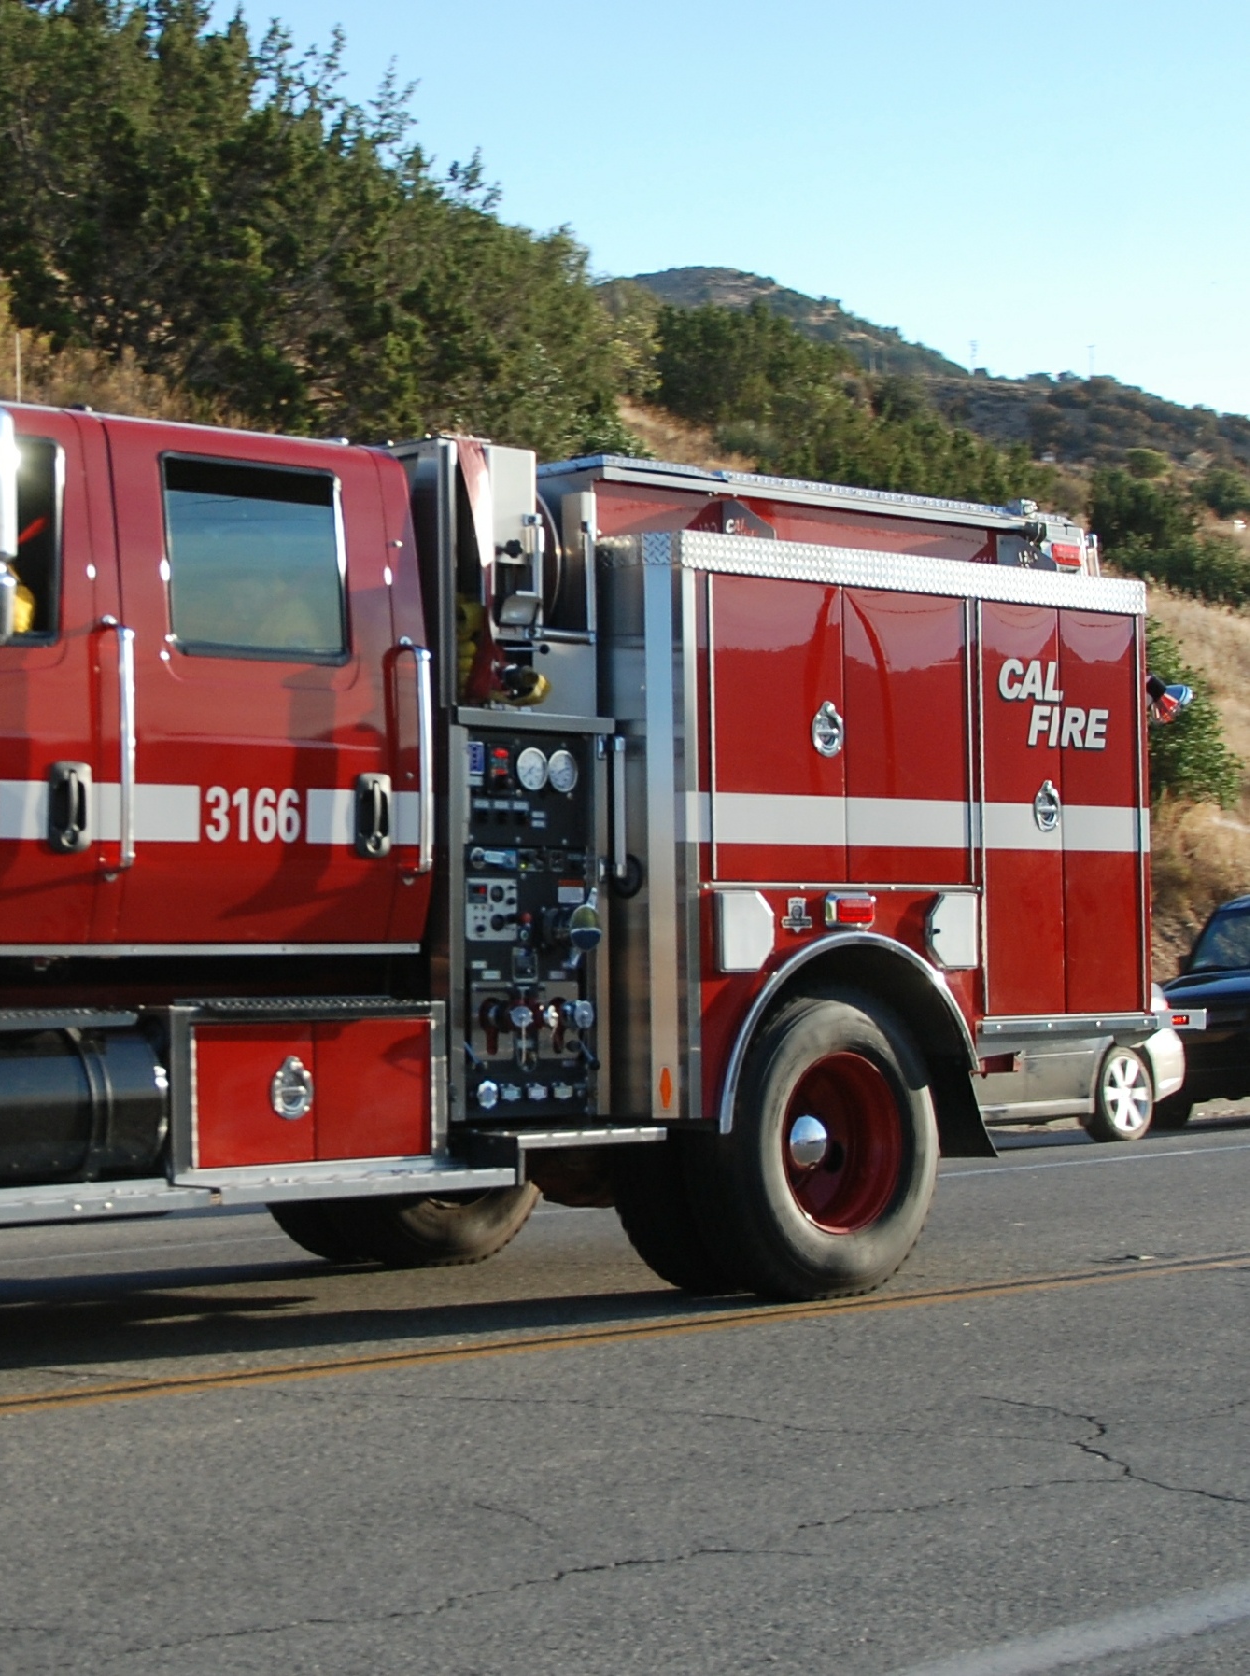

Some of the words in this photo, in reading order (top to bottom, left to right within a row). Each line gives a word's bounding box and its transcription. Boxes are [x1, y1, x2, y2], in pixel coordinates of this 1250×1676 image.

[998, 658, 1064, 702] CAL
[1027, 704, 1109, 748] FIRE
[205, 785, 300, 843] 3166
